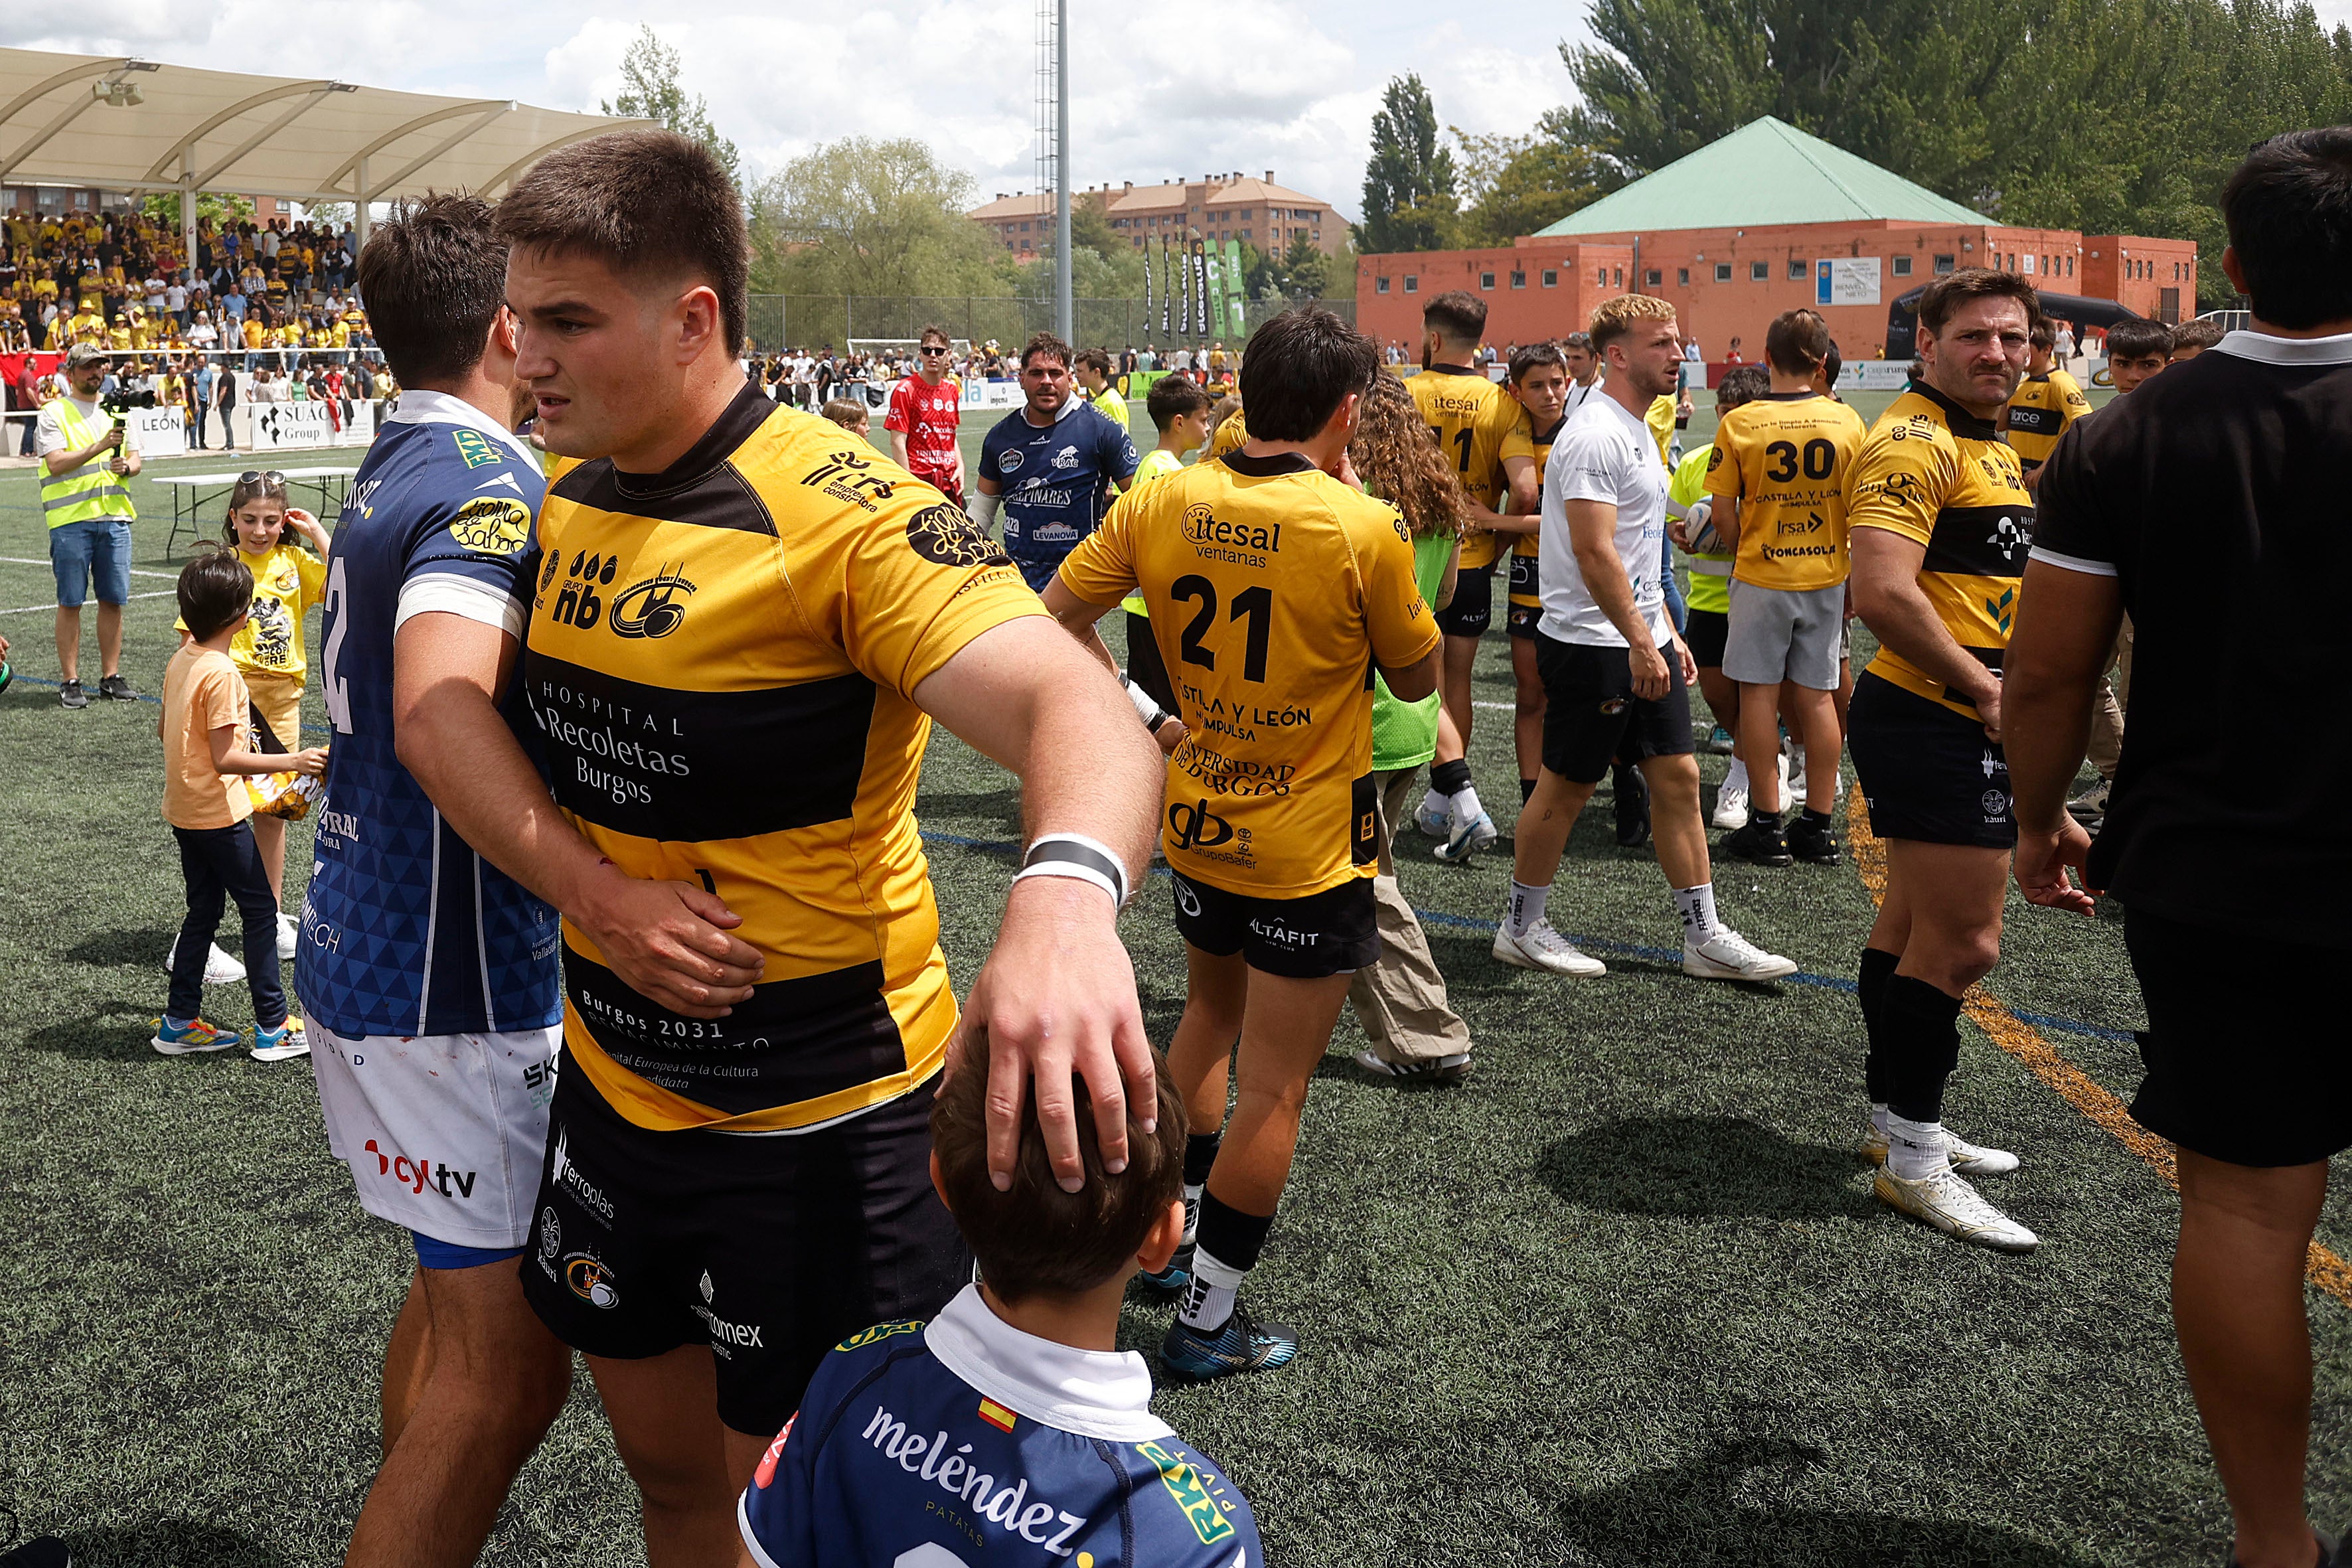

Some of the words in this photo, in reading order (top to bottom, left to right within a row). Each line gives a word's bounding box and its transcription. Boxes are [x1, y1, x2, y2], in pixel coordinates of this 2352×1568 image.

[1434, 394, 1479, 411] itesal
[284, 426, 320, 441] Group
[1051, 457, 1079, 468] VRAC
[1765, 437, 1836, 483] 30
[1755, 491, 1802, 505] CASTILLA
[1808, 491, 1816, 499] Y
[1034, 530, 1077, 540] LEVANOVA
[1196, 511, 1281, 553] itesal
[1196, 546, 1267, 568] ventanas
[552, 584, 601, 630] nb
[562, 580, 583, 592] GRUPO
[1170, 574, 1273, 684] 21
[543, 680, 684, 736] HOSPITAL
[1231, 702, 1245, 724] Y
[1253, 704, 1312, 727] LEÓN
[546, 706, 690, 776] Recoletas
[577, 755, 651, 804] Burgos
[1190, 843, 1257, 870] GrupoBafer
[583, 989, 647, 1030] Burgos
[659, 1020, 724, 1038] 2031
[635, 1056, 679, 1073] Europea
[682, 1064, 696, 1074] de
[699, 1064, 709, 1075] la
[713, 1065, 759, 1077] Cultura
[564, 1158, 614, 1219] ferroplas
[861, 1405, 1087, 1558] meléndez
[925, 1500, 984, 1547] PATATAS
